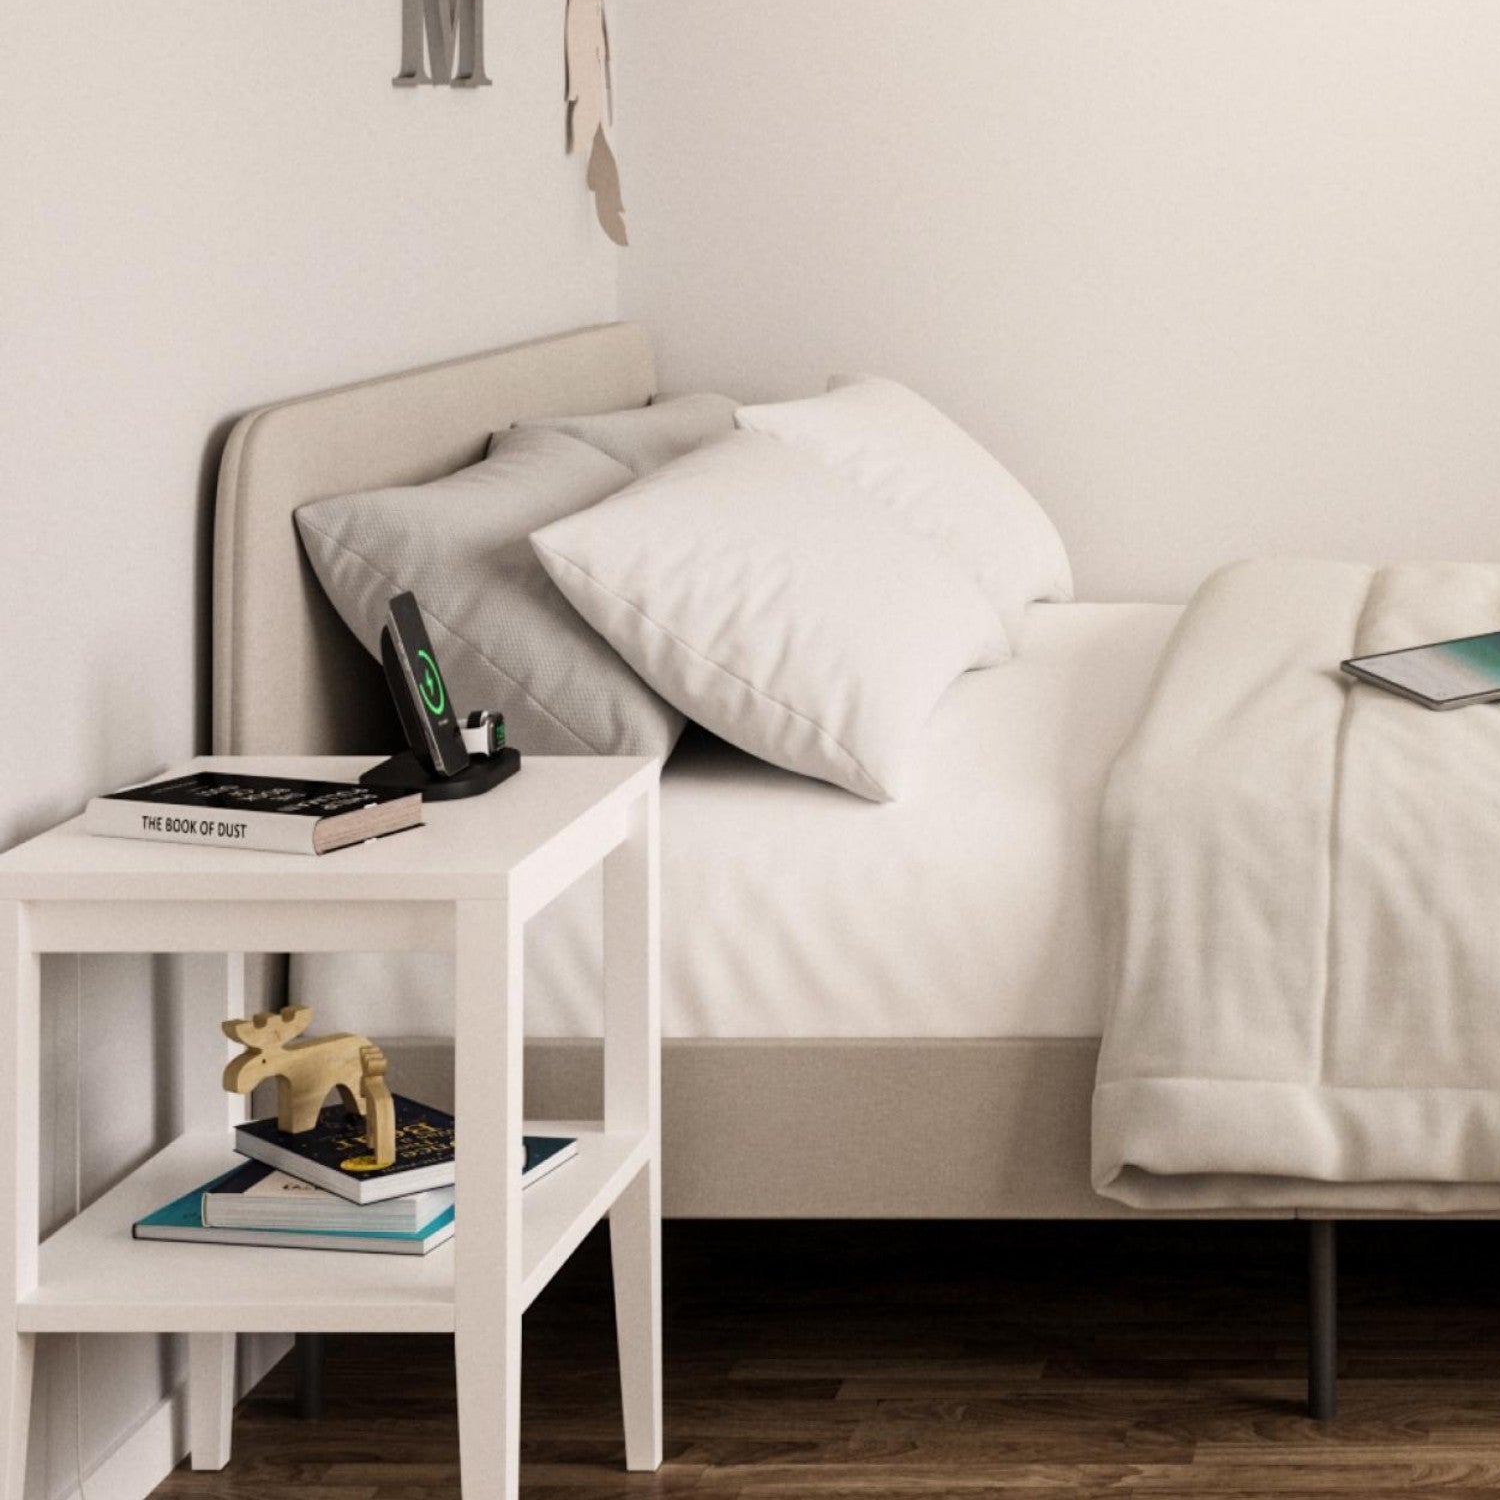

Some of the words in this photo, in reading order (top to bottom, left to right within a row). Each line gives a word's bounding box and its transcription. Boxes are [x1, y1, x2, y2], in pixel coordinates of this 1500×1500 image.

[141, 815, 162, 831] THE
[165, 817, 197, 834] BOOK
[199, 820, 215, 836] OF
[217, 822, 248, 839] DUST
